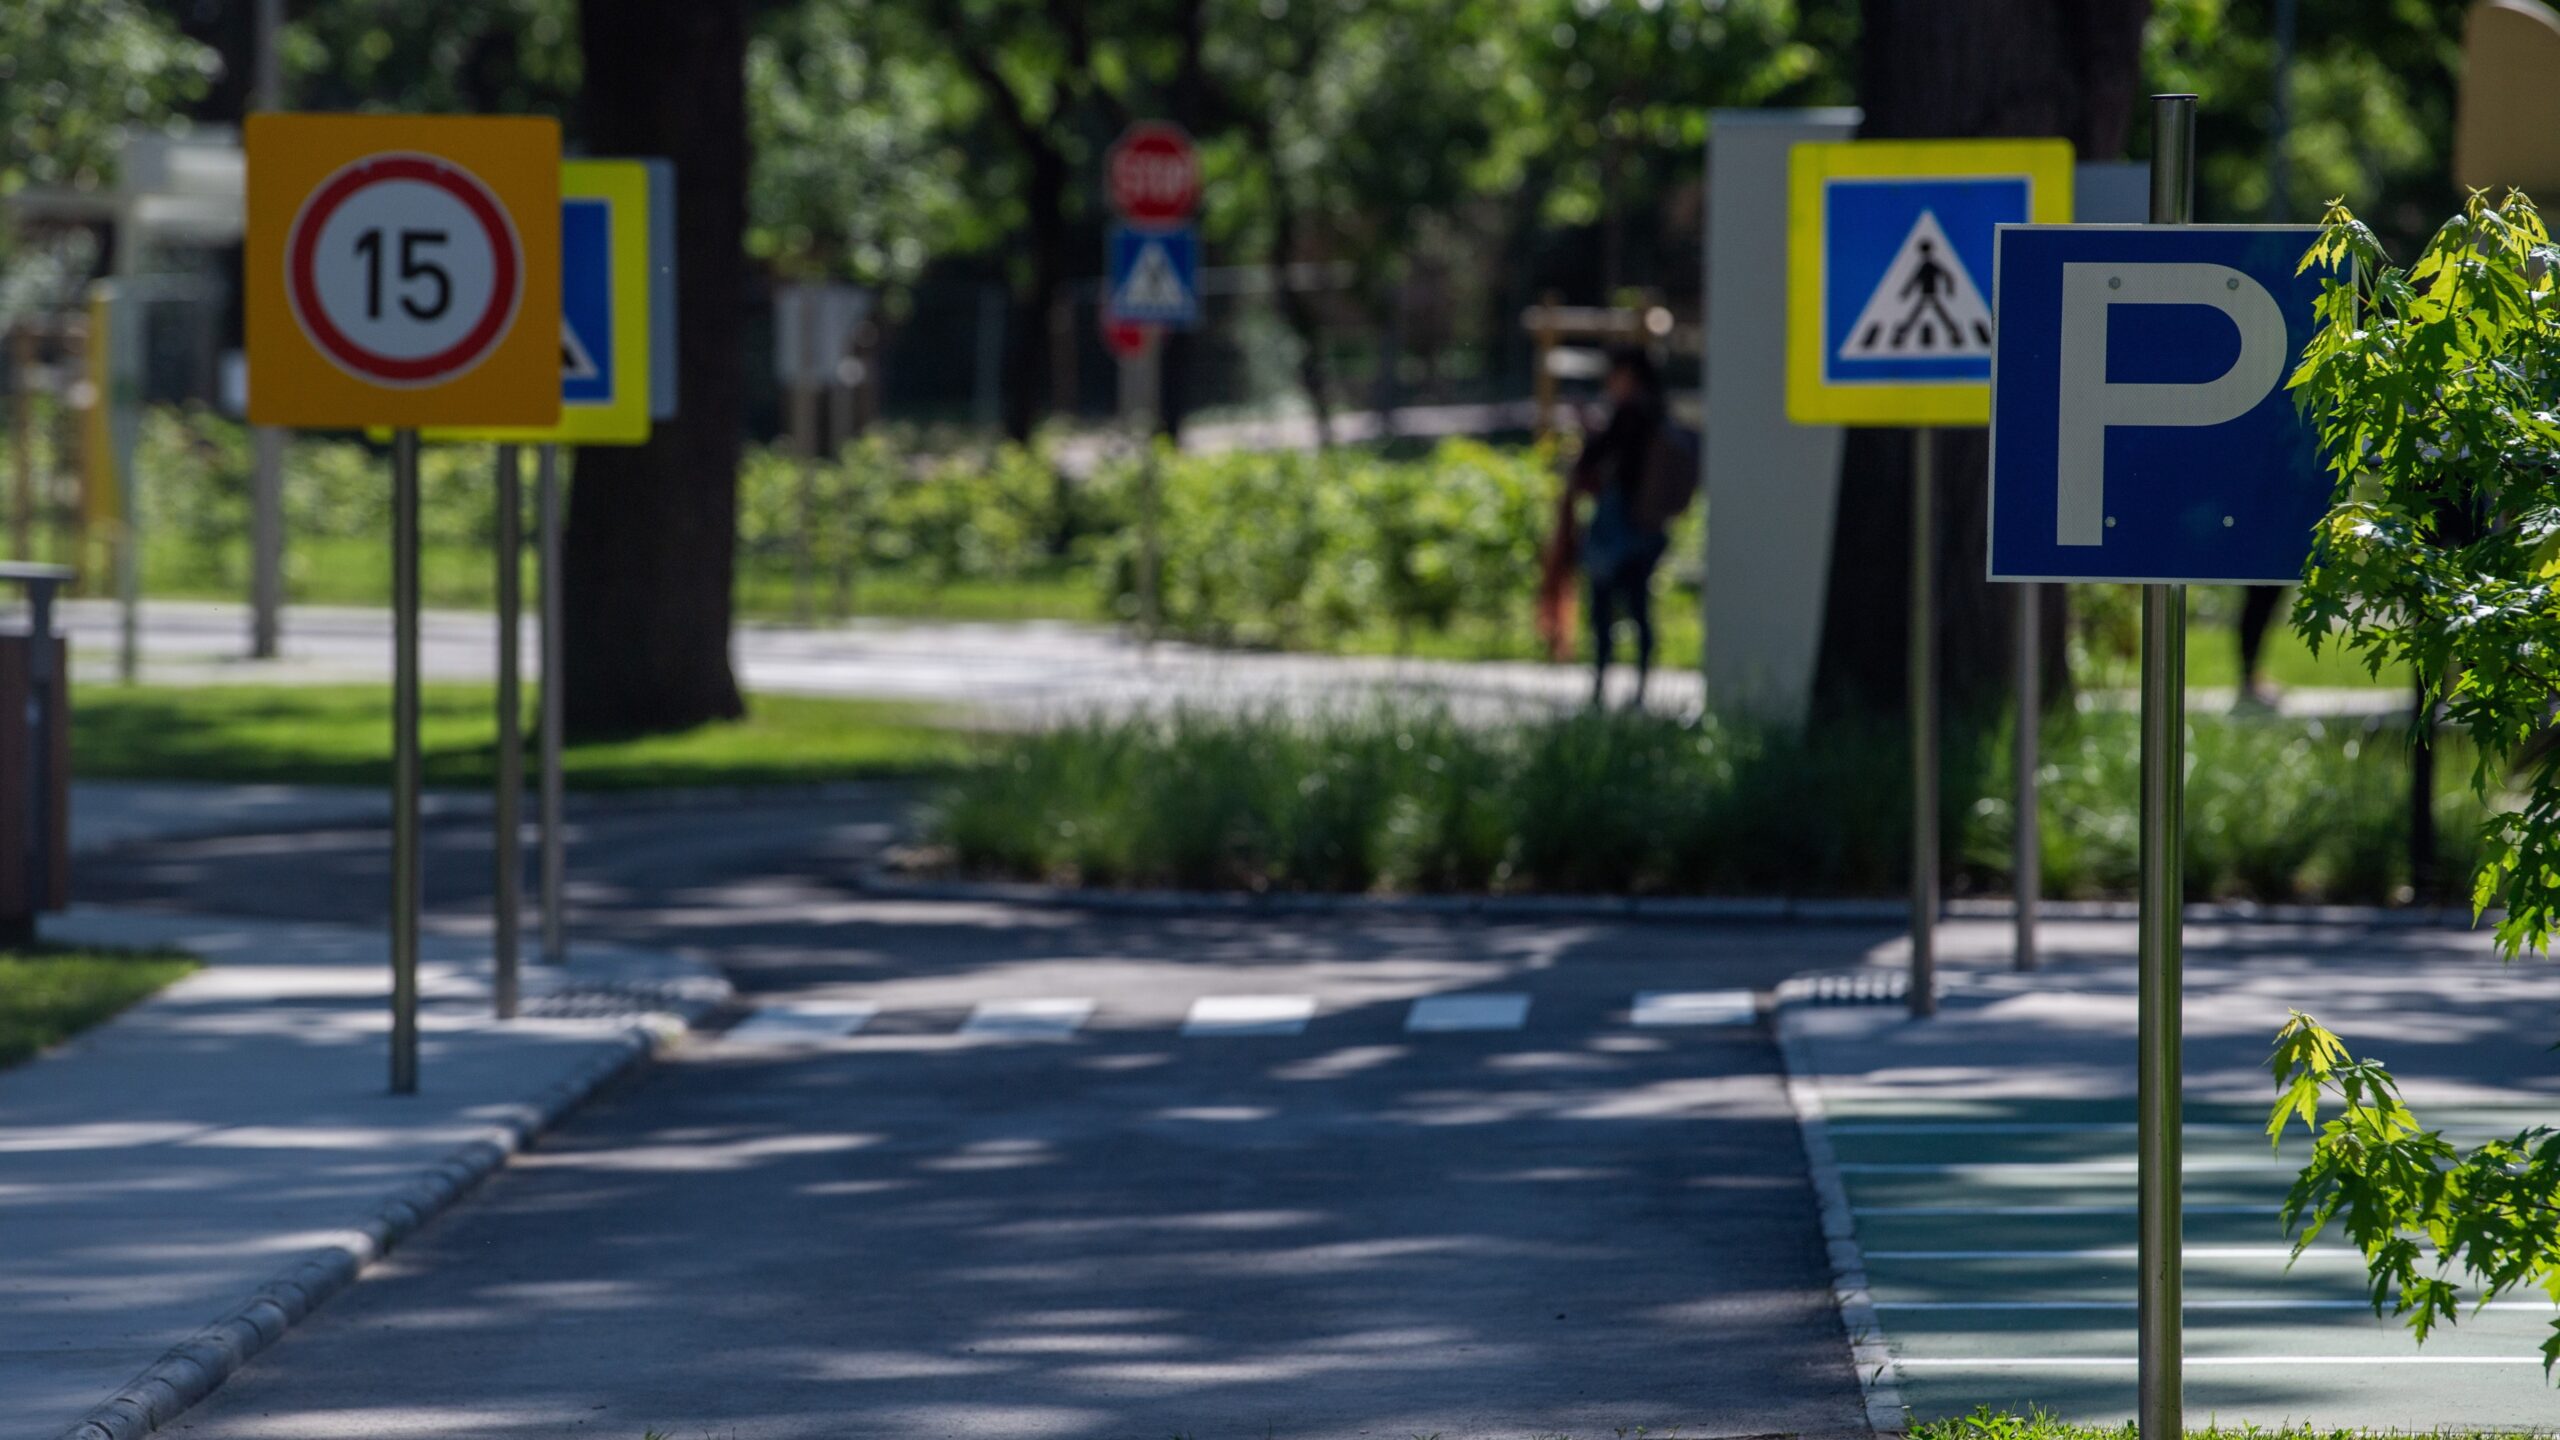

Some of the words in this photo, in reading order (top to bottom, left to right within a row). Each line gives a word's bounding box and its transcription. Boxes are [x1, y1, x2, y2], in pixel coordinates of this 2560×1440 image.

[1112, 153, 1196, 197] STOP
[354, 228, 452, 321] 15
[2057, 262, 2288, 546] P
